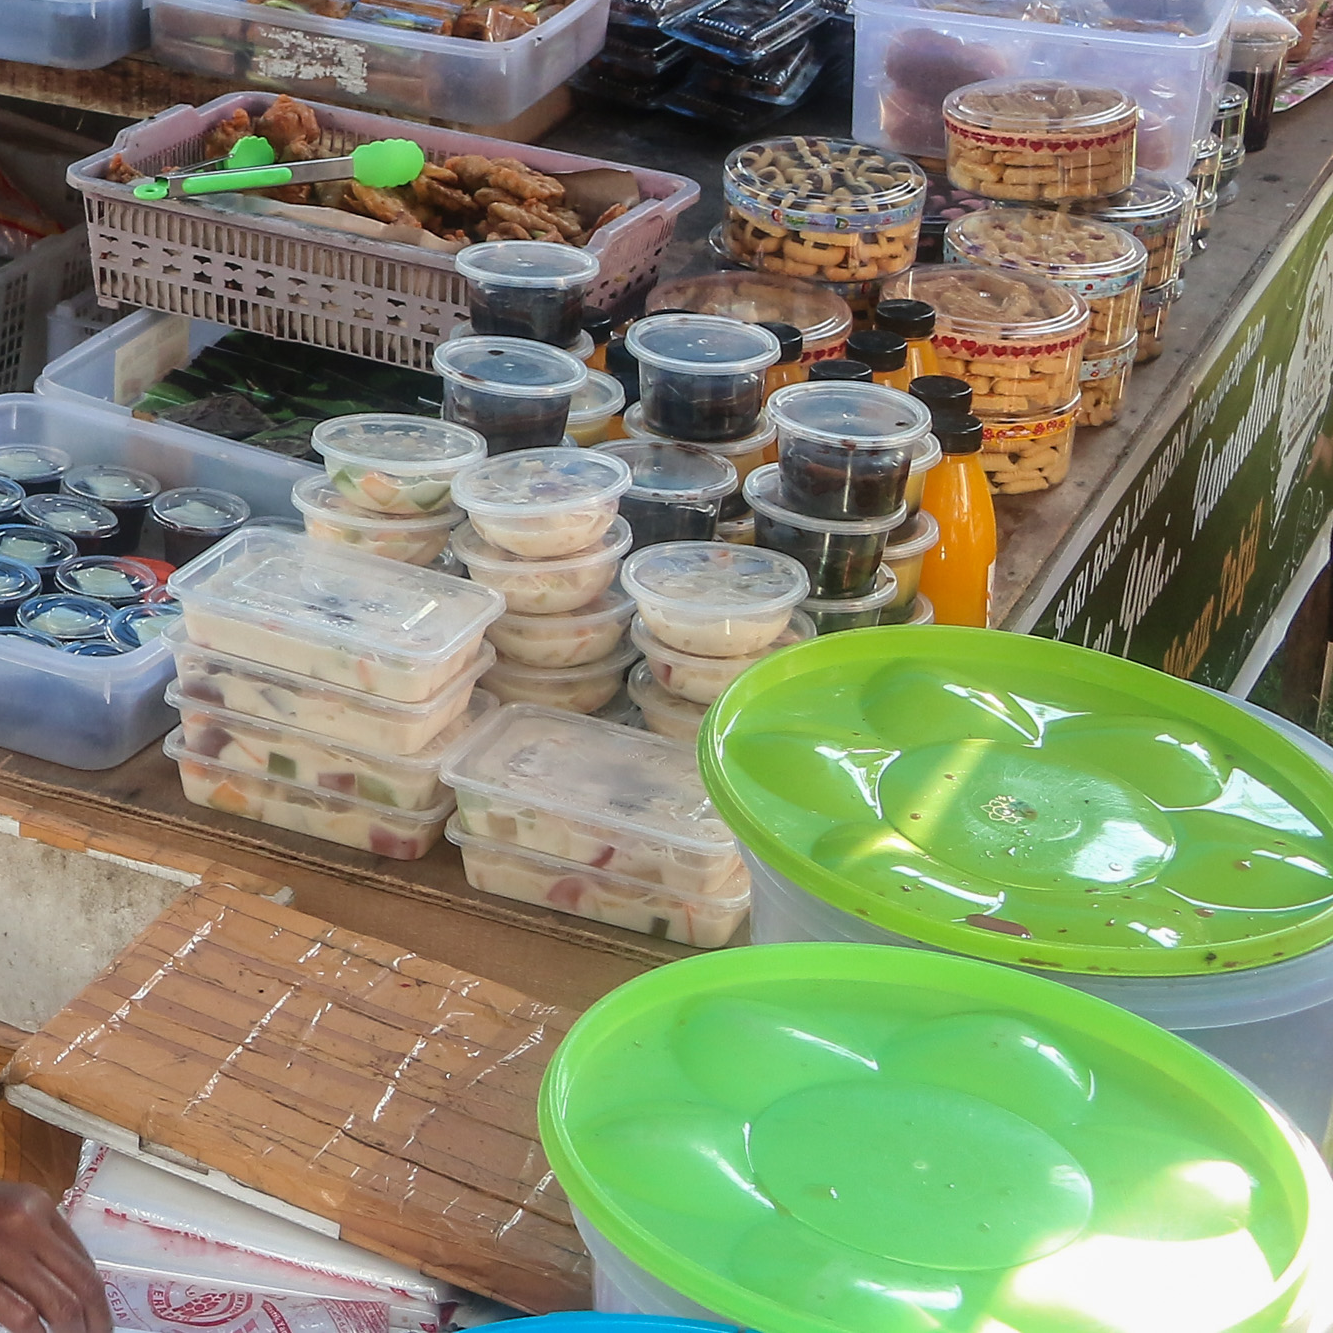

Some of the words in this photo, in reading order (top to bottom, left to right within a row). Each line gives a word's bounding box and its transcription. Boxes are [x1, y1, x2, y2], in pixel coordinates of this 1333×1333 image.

[1053, 561, 1090, 641] SARI
[1089, 513, 1131, 596] RASA
[1130, 416, 1190, 536] LOMBOK
[1187, 314, 1267, 449] Mengucapkan
[1191, 355, 1282, 542] Ramadhan
